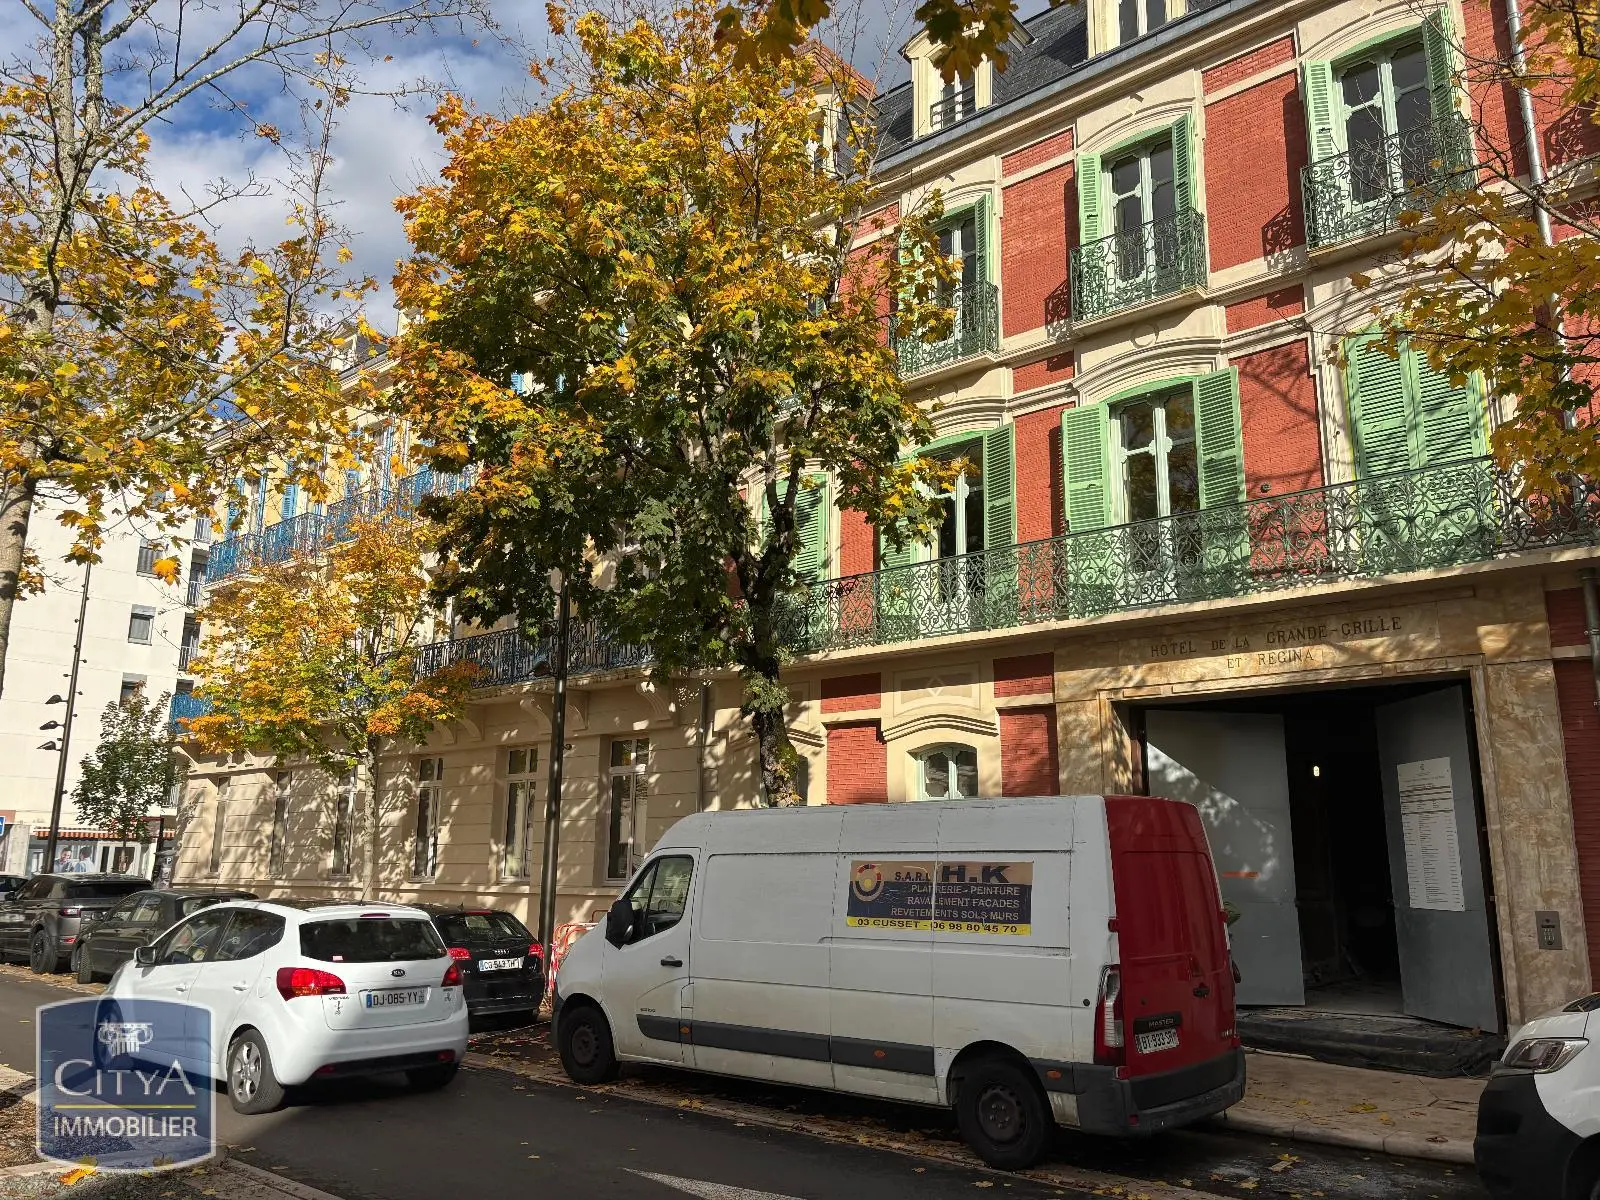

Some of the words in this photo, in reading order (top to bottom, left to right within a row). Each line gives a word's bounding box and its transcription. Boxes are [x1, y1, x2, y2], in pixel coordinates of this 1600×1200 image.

[1211, 639, 1226, 651] DE
[1235, 636, 1250, 649] LA
[1227, 658, 1243, 669] ET
[1258, 648, 1314, 667] REGINA
[942, 865, 1011, 884] H.K
[970, 885, 1020, 896] PEINTURE
[961, 910, 987, 919] SOLS
[989, 911, 1019, 921] MURS
[857, 918, 870, 926] 03
[873, 919, 921, 929] CUSSET
[930, 921, 945, 930] 06
[948, 922, 962, 931] 98
[966, 923, 980, 932] 80
[983, 924, 999, 933] 45
[1002, 925, 1017, 934] 70
